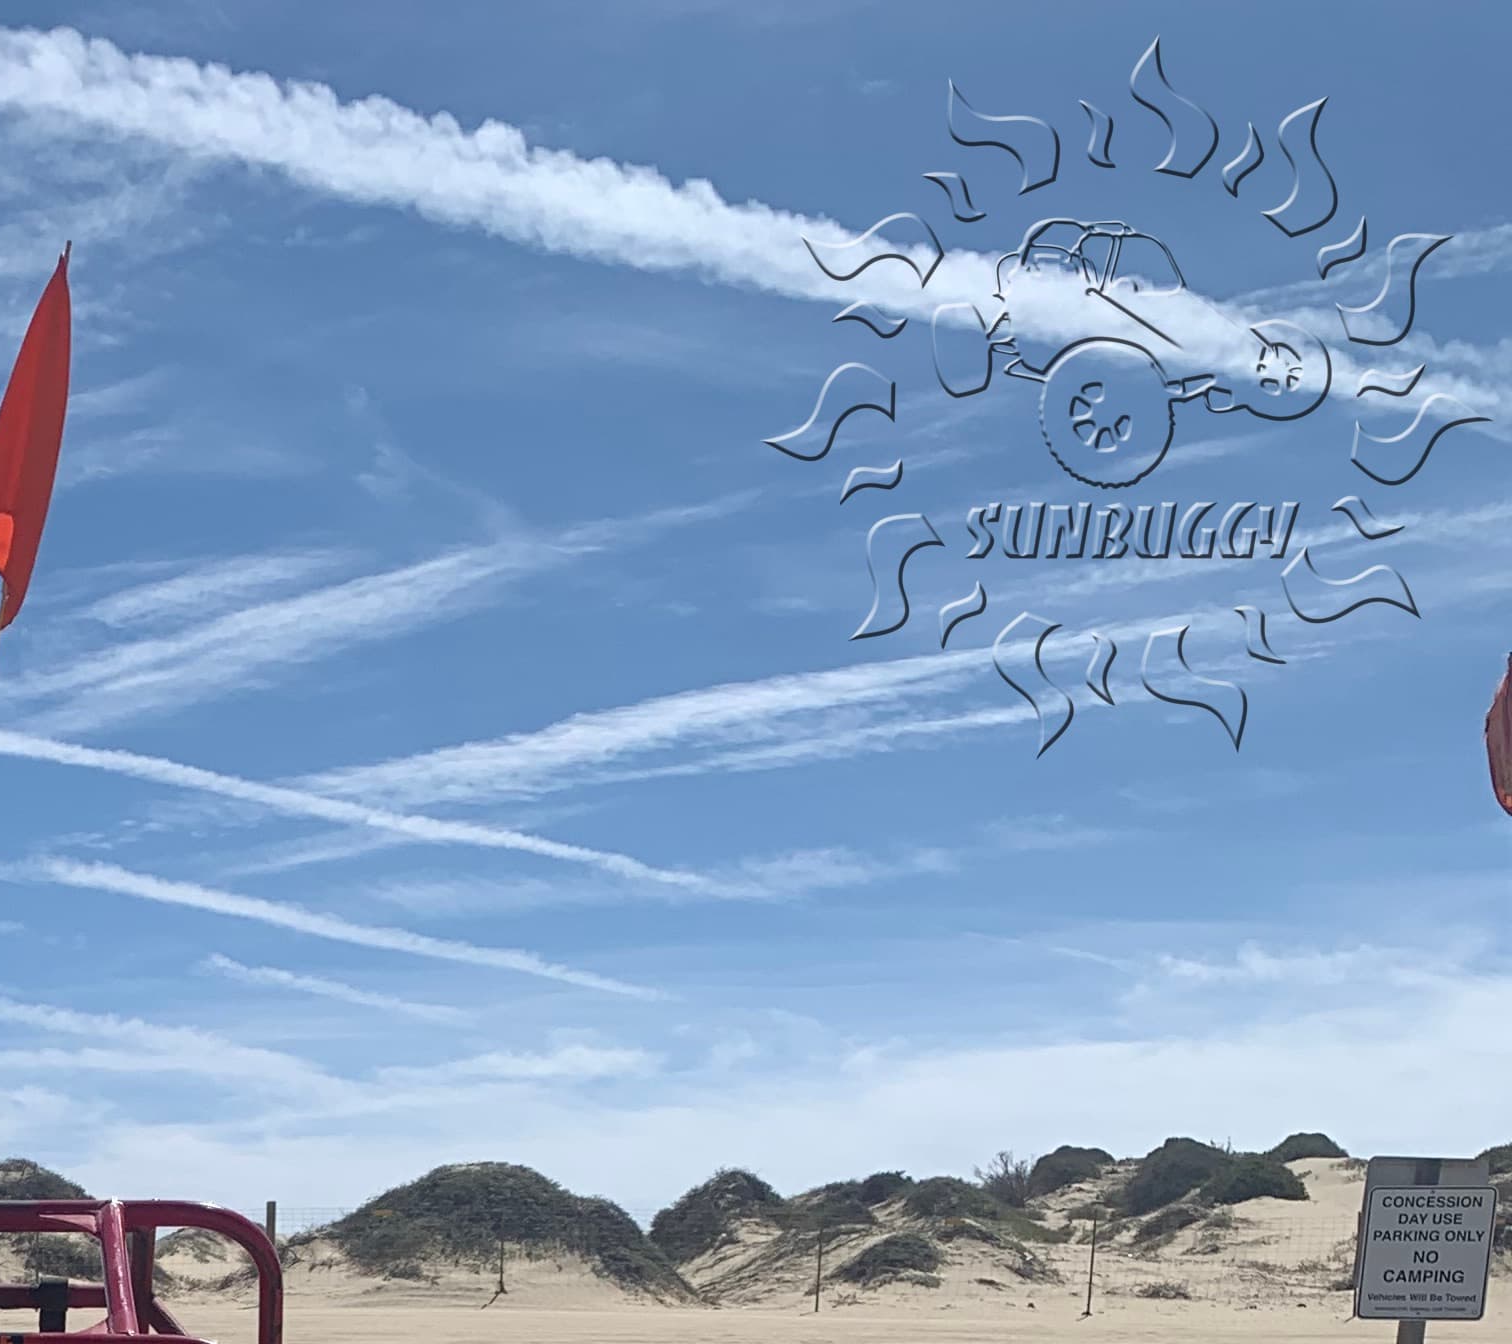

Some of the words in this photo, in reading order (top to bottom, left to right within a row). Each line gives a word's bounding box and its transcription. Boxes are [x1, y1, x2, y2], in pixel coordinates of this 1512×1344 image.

[1382, 1195, 1484, 1208] CONCESSION
[1398, 1213, 1428, 1225] DAY
[1432, 1213, 1463, 1225] USE
[1373, 1230, 1440, 1242] PARKING
[1444, 1230, 1485, 1242] ONLY
[1413, 1250, 1439, 1264] NO
[1383, 1269, 1465, 1283] CAMPING
